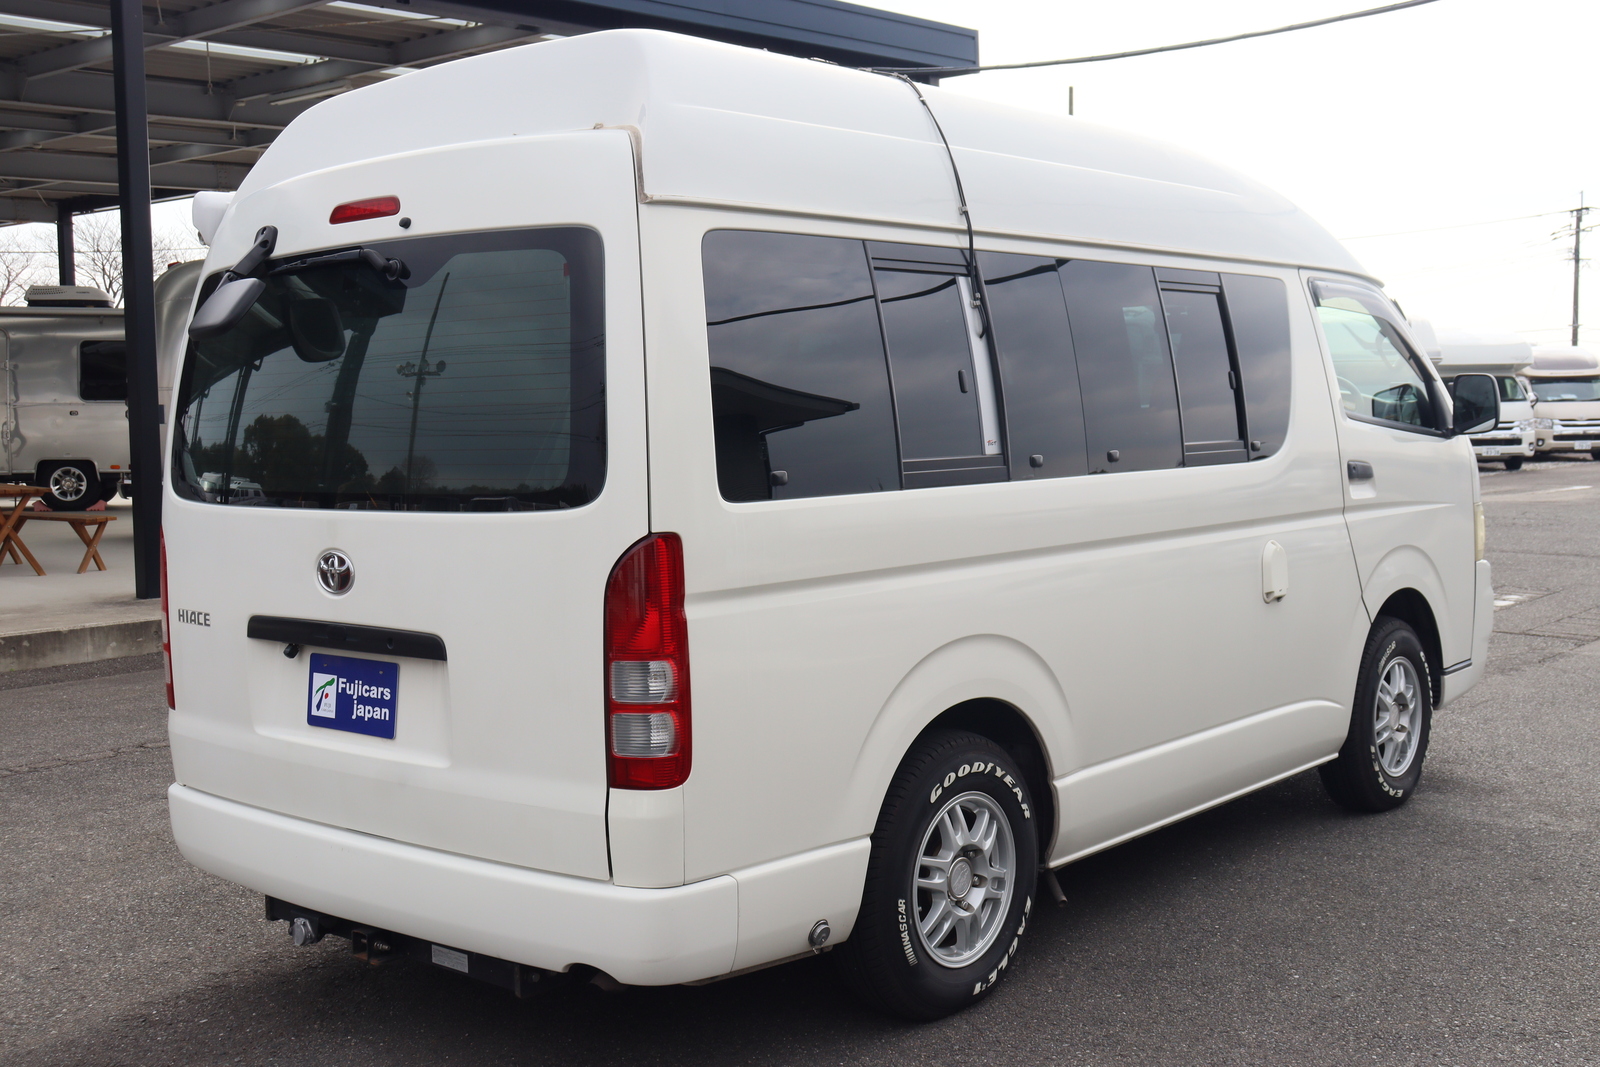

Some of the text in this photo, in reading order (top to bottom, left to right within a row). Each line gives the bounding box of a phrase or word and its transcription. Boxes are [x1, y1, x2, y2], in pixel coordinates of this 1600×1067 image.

[178, 608, 211, 627] HIACE
[338, 677, 392, 701] Fujicars
[351, 699, 390, 722] japan
[929, 761, 1031, 820] GOODYEAR
[897, 898, 912, 947] NASCAR
[987, 895, 1032, 988] EAGLE
